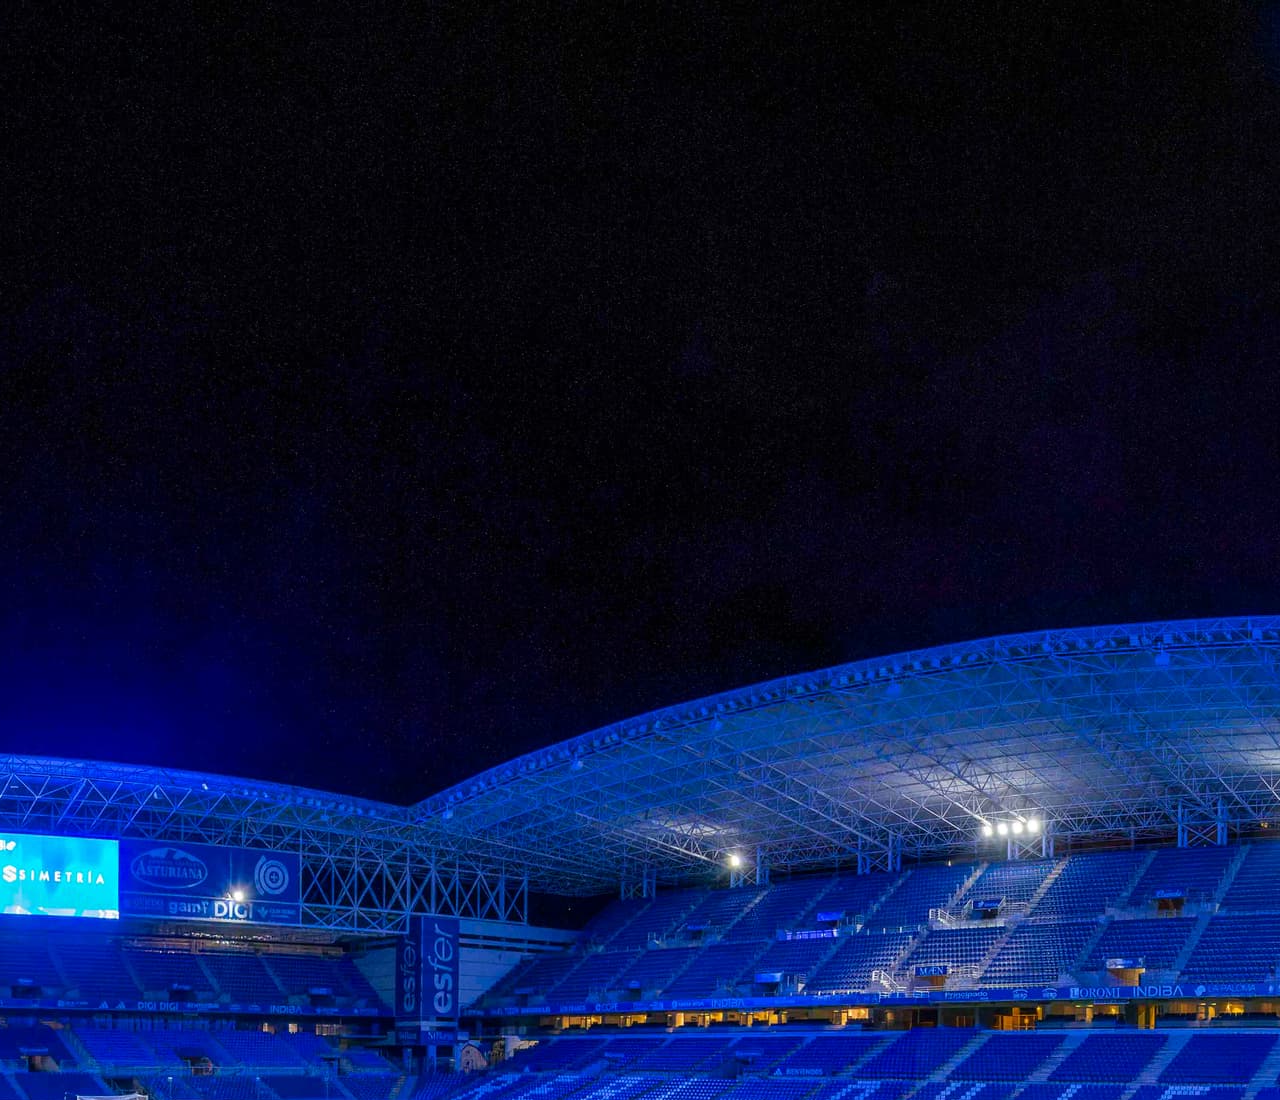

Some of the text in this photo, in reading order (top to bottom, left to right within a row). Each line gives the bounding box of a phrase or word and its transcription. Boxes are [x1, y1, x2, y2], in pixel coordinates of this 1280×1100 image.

[18, 868, 105, 885] SIMETRÍA
[135, 860, 203, 880] ASTURIANA
[213, 899, 254, 920] DIGI
[400, 936, 417, 1012] esfer
[427, 923, 454, 1014] esfer
[1070, 987, 1121, 999] LOROMI
[1132, 985, 1184, 998] INDIBA
[270, 1004, 302, 1014] INDIBA
